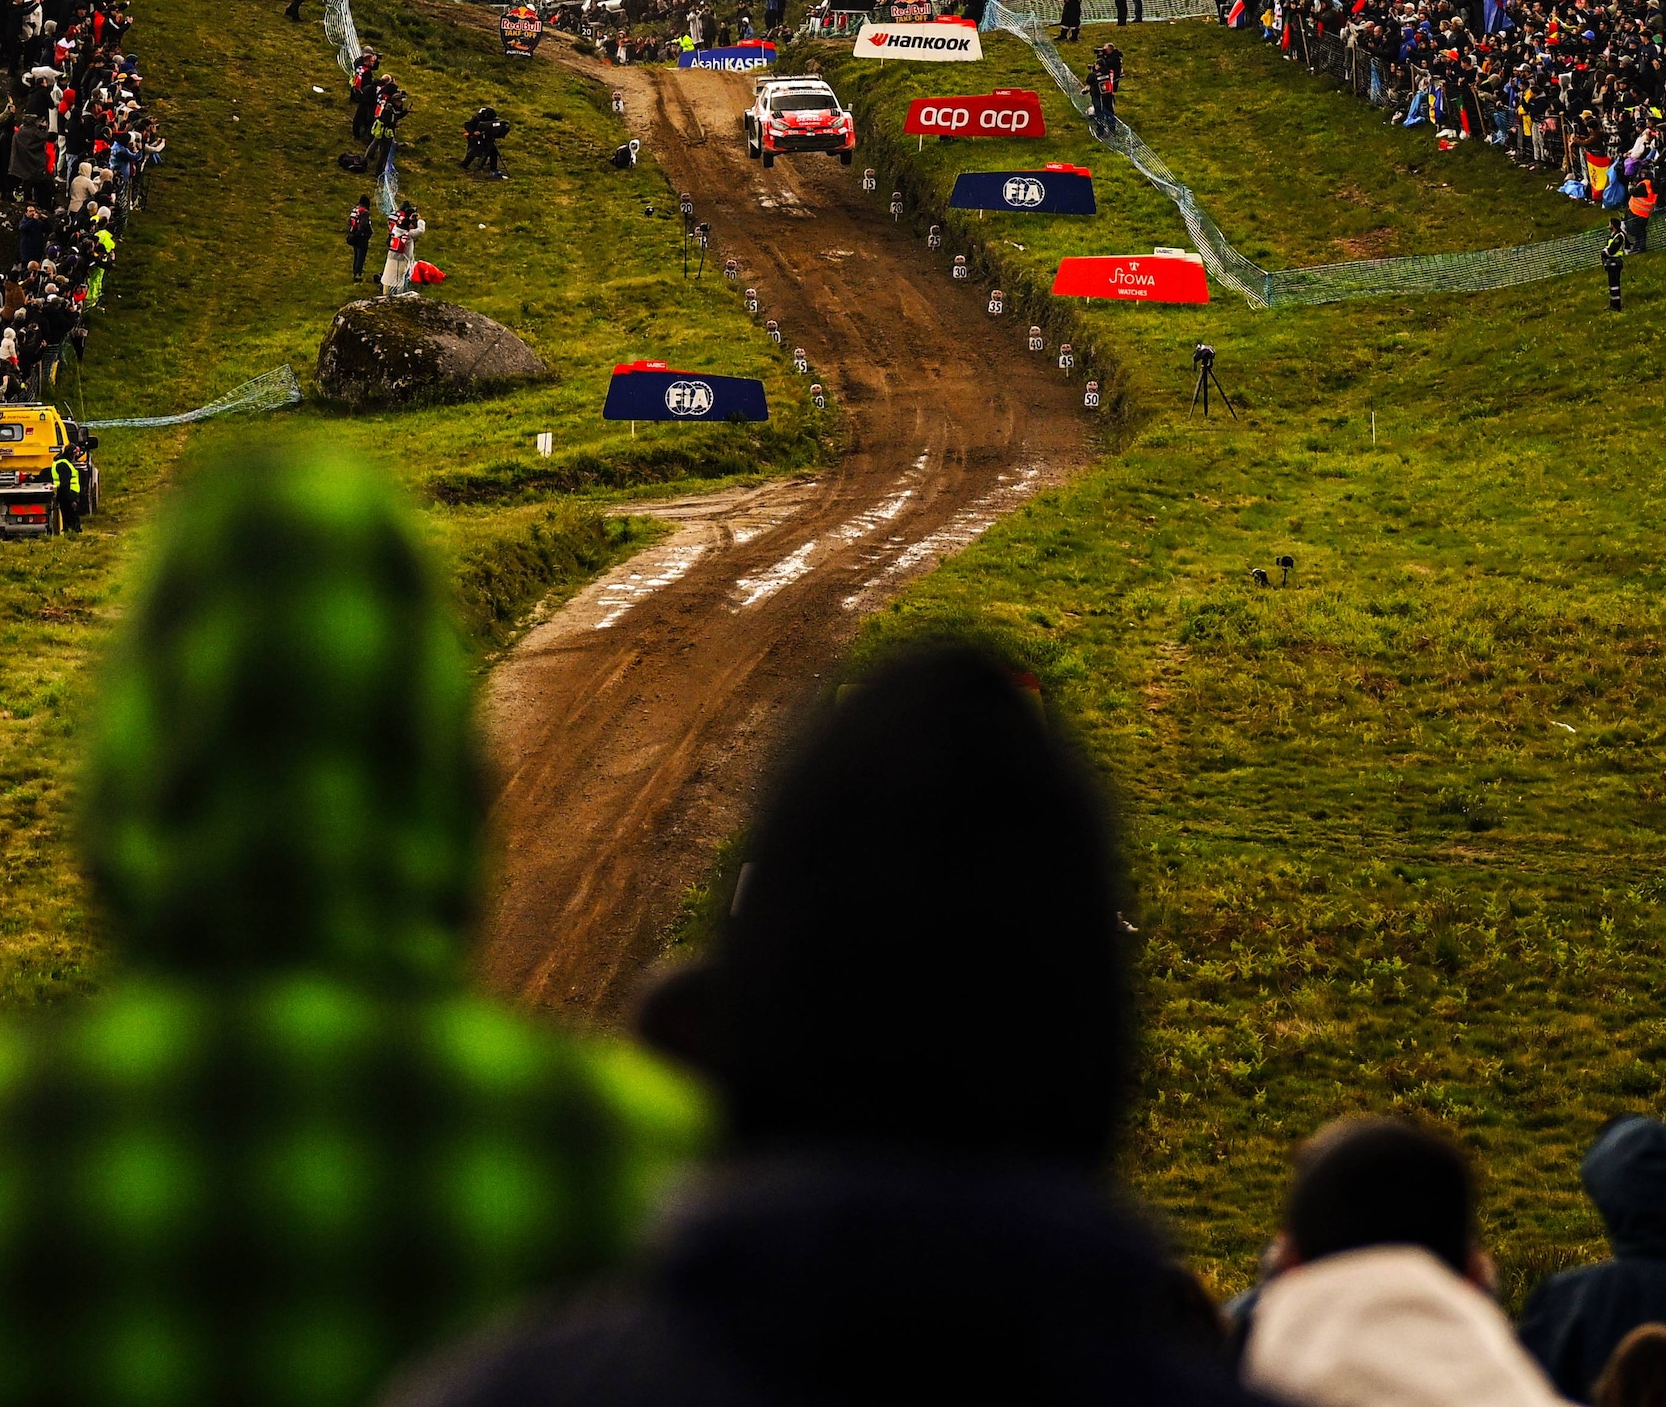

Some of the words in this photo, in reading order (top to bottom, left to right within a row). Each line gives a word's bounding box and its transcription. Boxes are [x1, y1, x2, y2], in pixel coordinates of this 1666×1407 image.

[891, 5, 910, 16] Red
[912, 3, 931, 15] Bull
[502, 18, 522, 31] Red
[522, 20, 542, 32] Bull
[582, 28, 591, 36] 20
[615, 102, 620, 111] 5
[919, 107, 969, 130] acp
[979, 109, 1030, 132] acp
[866, 180, 874, 189] 15
[1006, 183, 1039, 201] FIA
[892, 204, 902, 212] 20
[930, 237, 940, 246] 25
[955, 267, 965, 277] 30
[1118, 288, 1147, 296] WATCHES
[990, 302, 1001, 312] 35
[1031, 339, 1042, 349] 40
[1061, 357, 1073, 367] 45
[669, 388, 709, 408] FIA
[1086, 395, 1098, 405] 50
